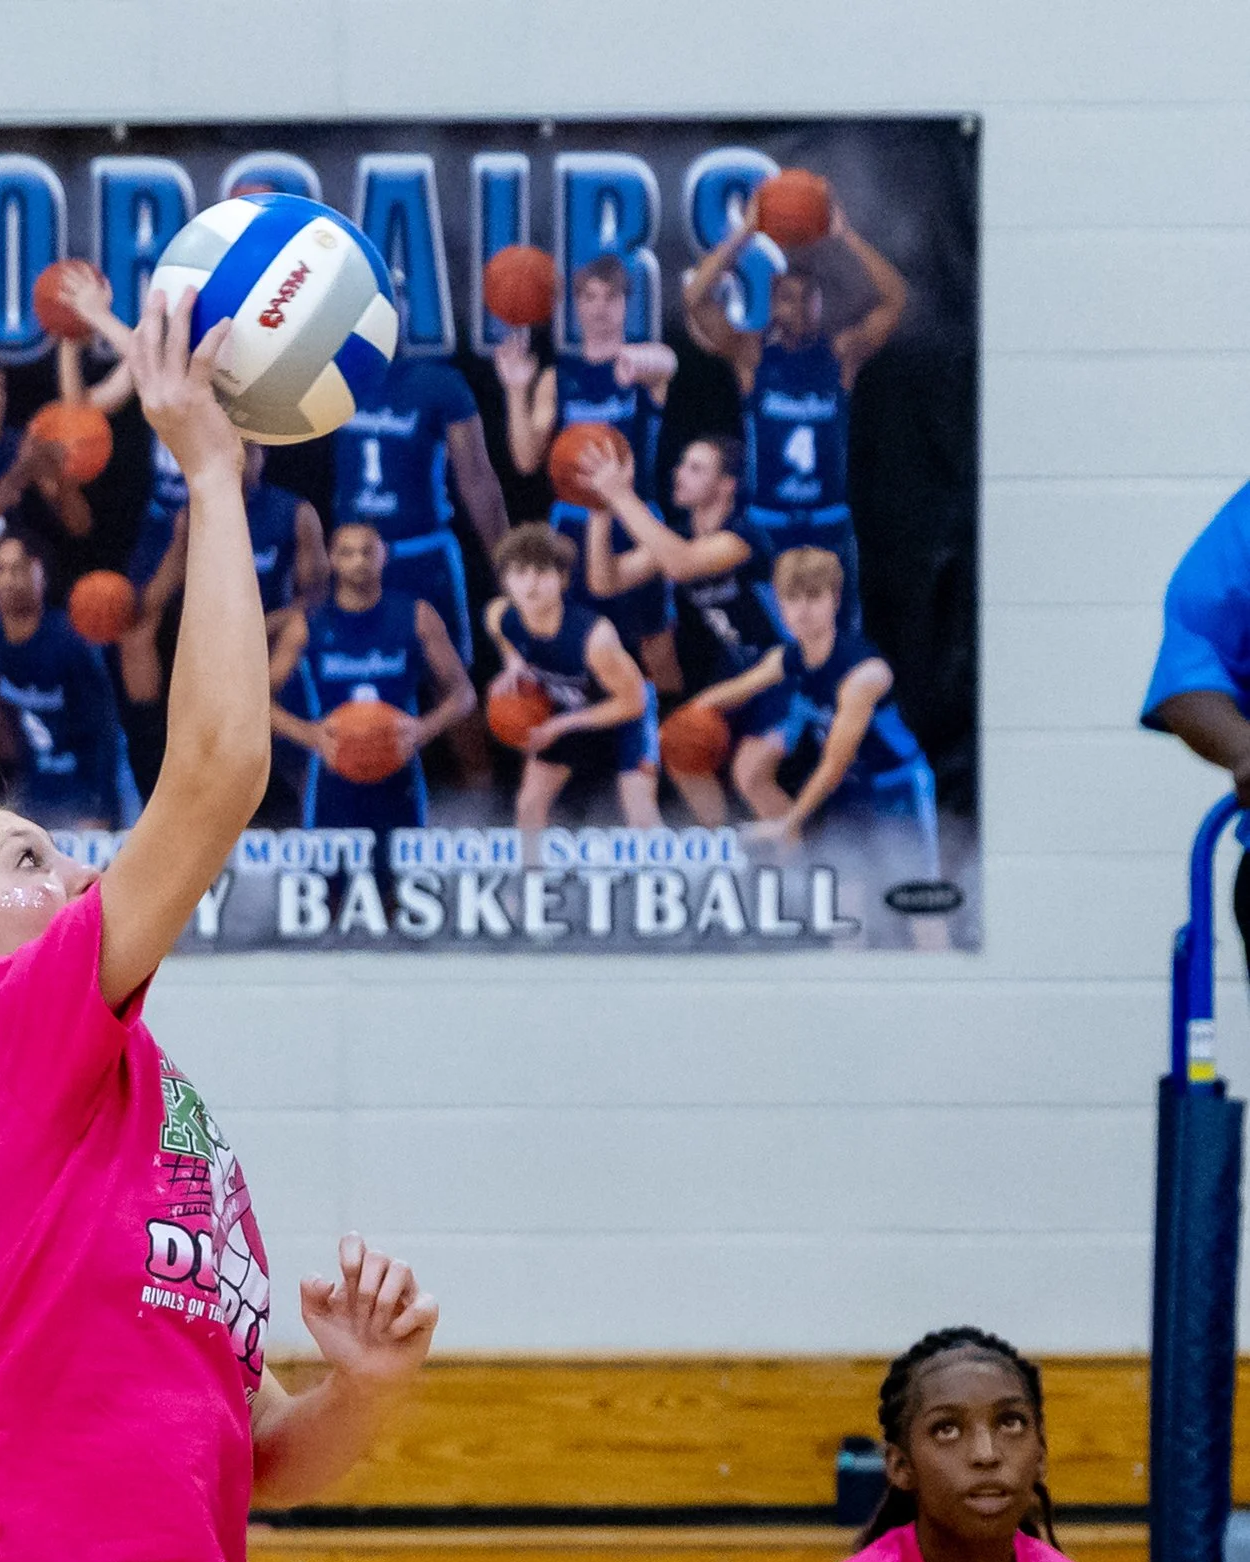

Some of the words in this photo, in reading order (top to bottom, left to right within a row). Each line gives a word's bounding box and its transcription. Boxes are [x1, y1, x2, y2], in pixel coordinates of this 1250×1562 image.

[237, 828, 375, 876] MOTT
[391, 828, 522, 873] HIGH
[540, 827, 749, 877] SCHOOL
[278, 867, 864, 941] BASKETBALL
[141, 1285, 184, 1312] RIVALS
[187, 1298, 206, 1318] ON
